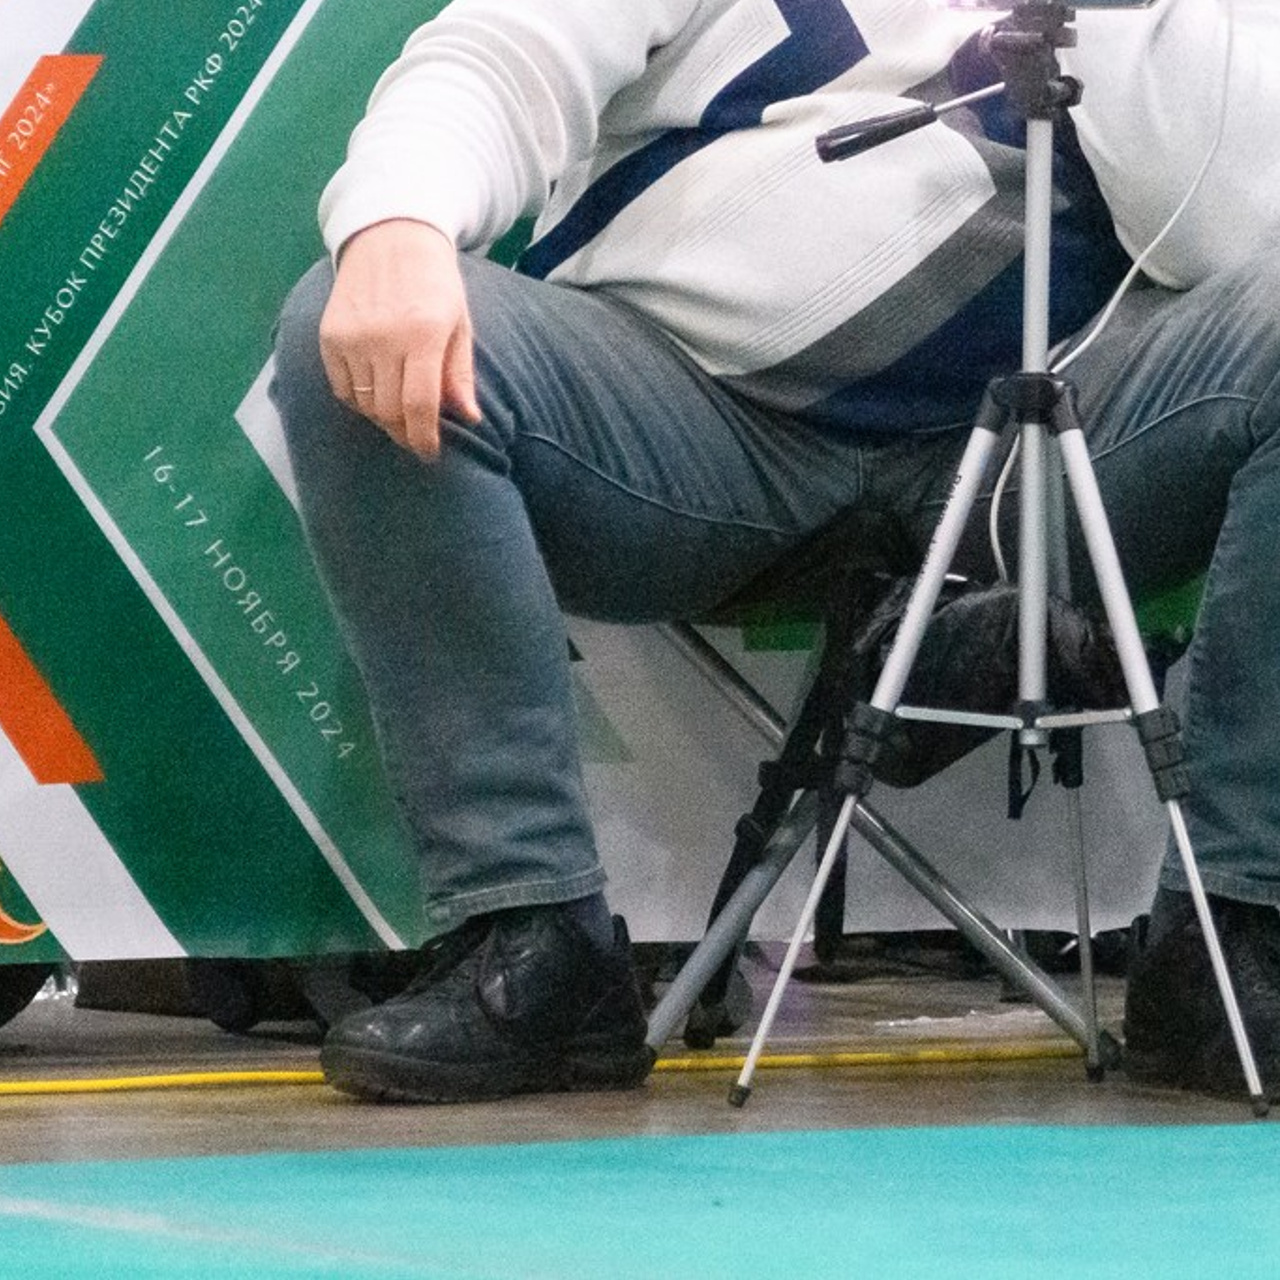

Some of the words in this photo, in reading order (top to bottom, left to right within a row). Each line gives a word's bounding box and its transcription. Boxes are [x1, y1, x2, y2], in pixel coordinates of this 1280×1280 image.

[7, 82, 55, 151] 2024»
[25, 272, 88, 356] КУБОК
[80, 106, 195, 269] ПРЕЗИДЕНТА
[184, 52, 223, 106] РКФ
[143, 445, 207, 529] 16-17
[204, 539, 301, 675] НОЯБРЯ
[296, 682, 356, 761] 2024
